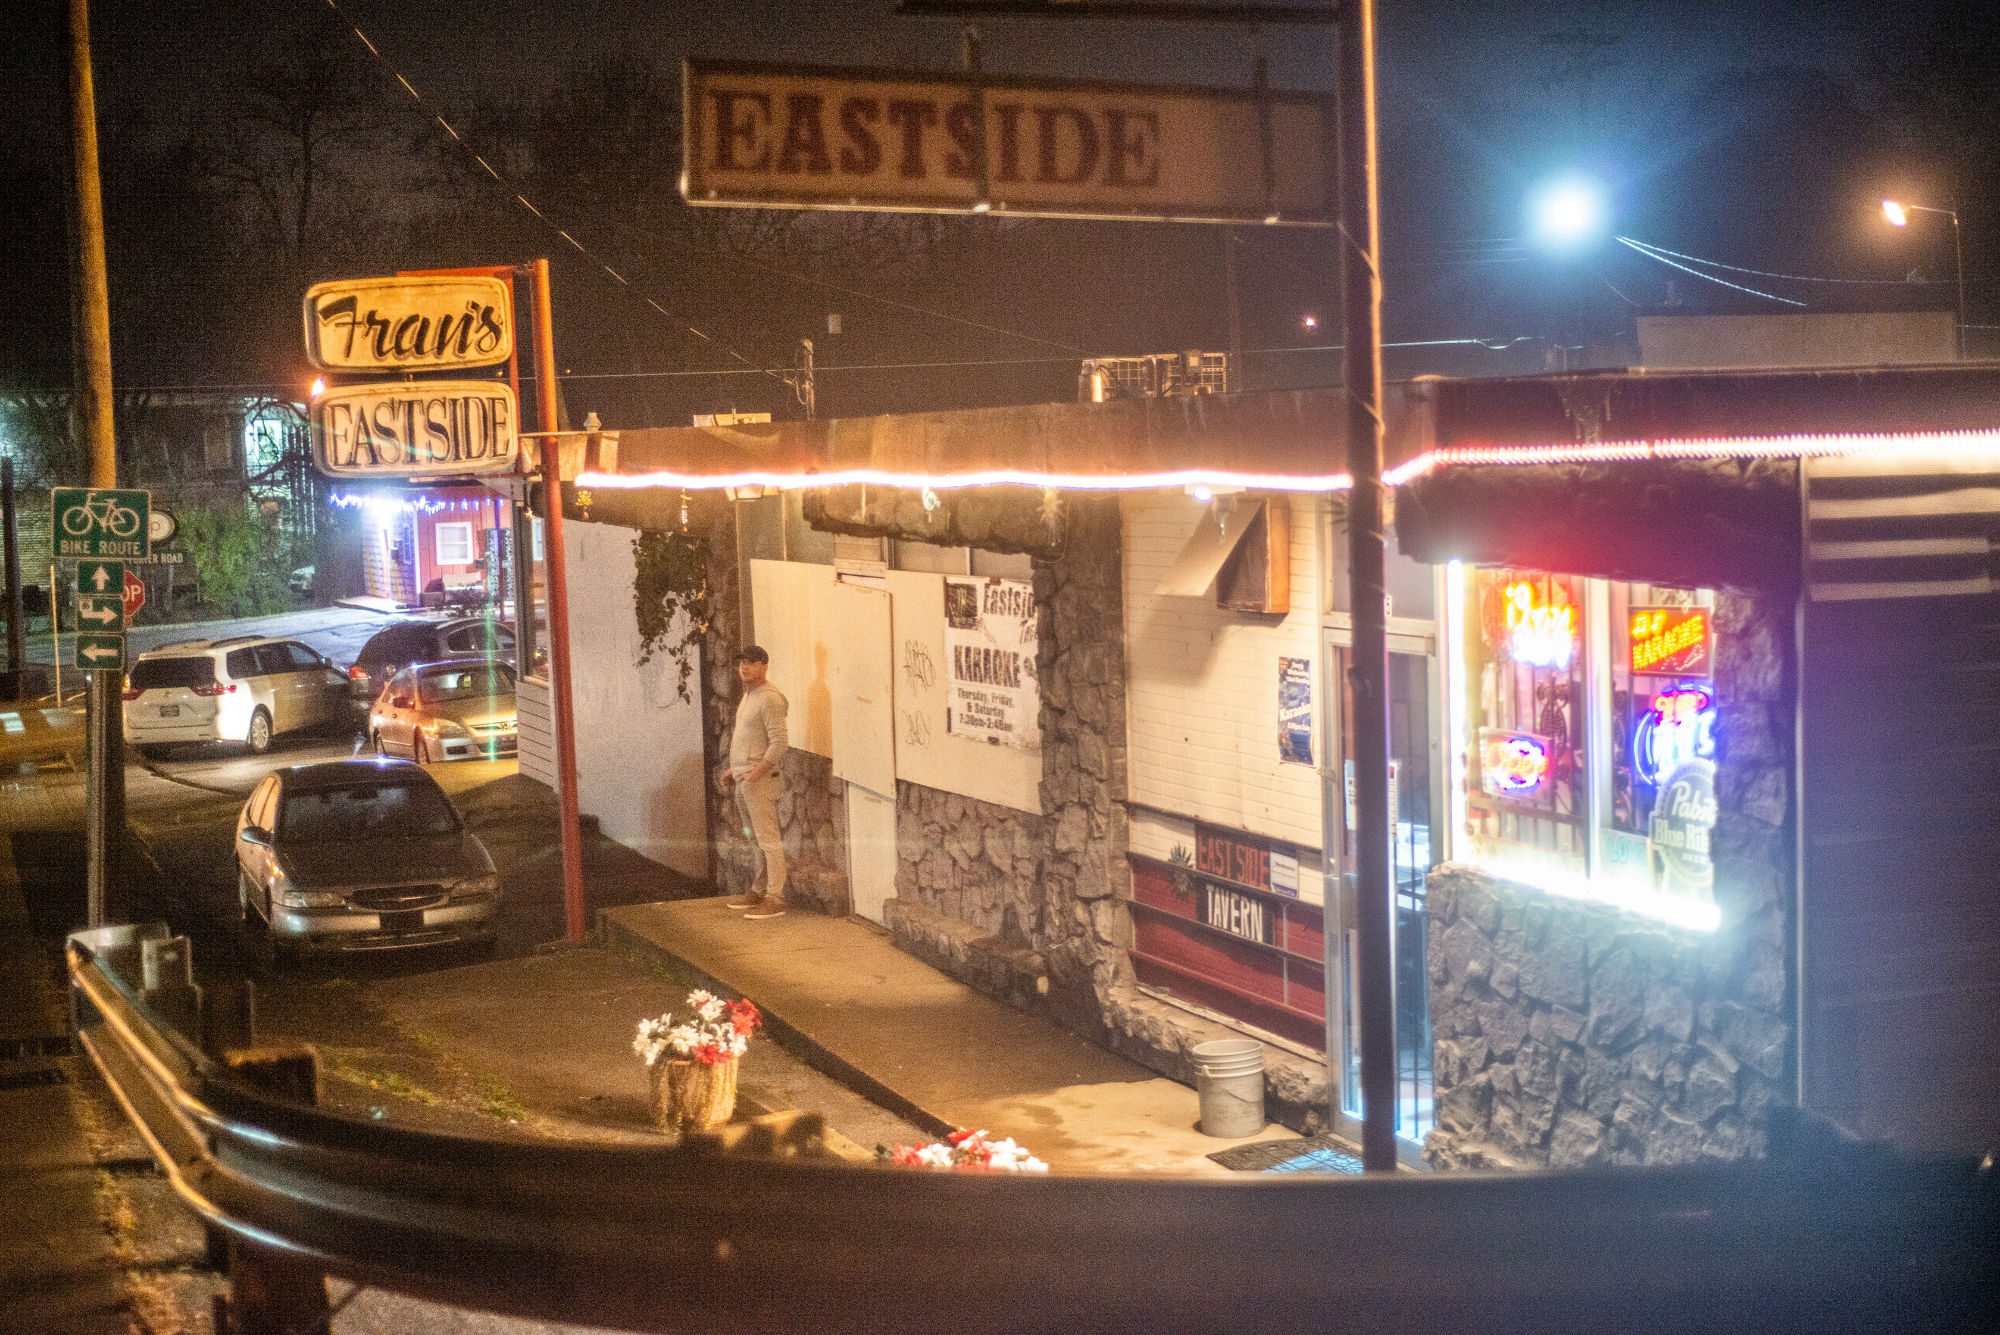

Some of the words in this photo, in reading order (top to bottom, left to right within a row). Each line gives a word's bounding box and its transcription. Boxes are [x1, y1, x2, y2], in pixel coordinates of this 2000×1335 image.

[706, 90, 1160, 187] EASTSIDE
[318, 295, 503, 361] Fran's
[327, 396, 509, 467] EASTSIDE
[60, 541, 91, 554] BIKE
[99, 541, 140, 555] ROUTE
[161, 553, 184, 564] ROAD
[954, 645, 1021, 688] KARAOKE
[1632, 614, 1704, 669] KARAOKE
[1655, 818, 1685, 848] Blue
[1198, 833, 1232, 880] EAST
[1236, 843, 1270, 891] SIDE
[1206, 883, 1263, 943] TAVERN
